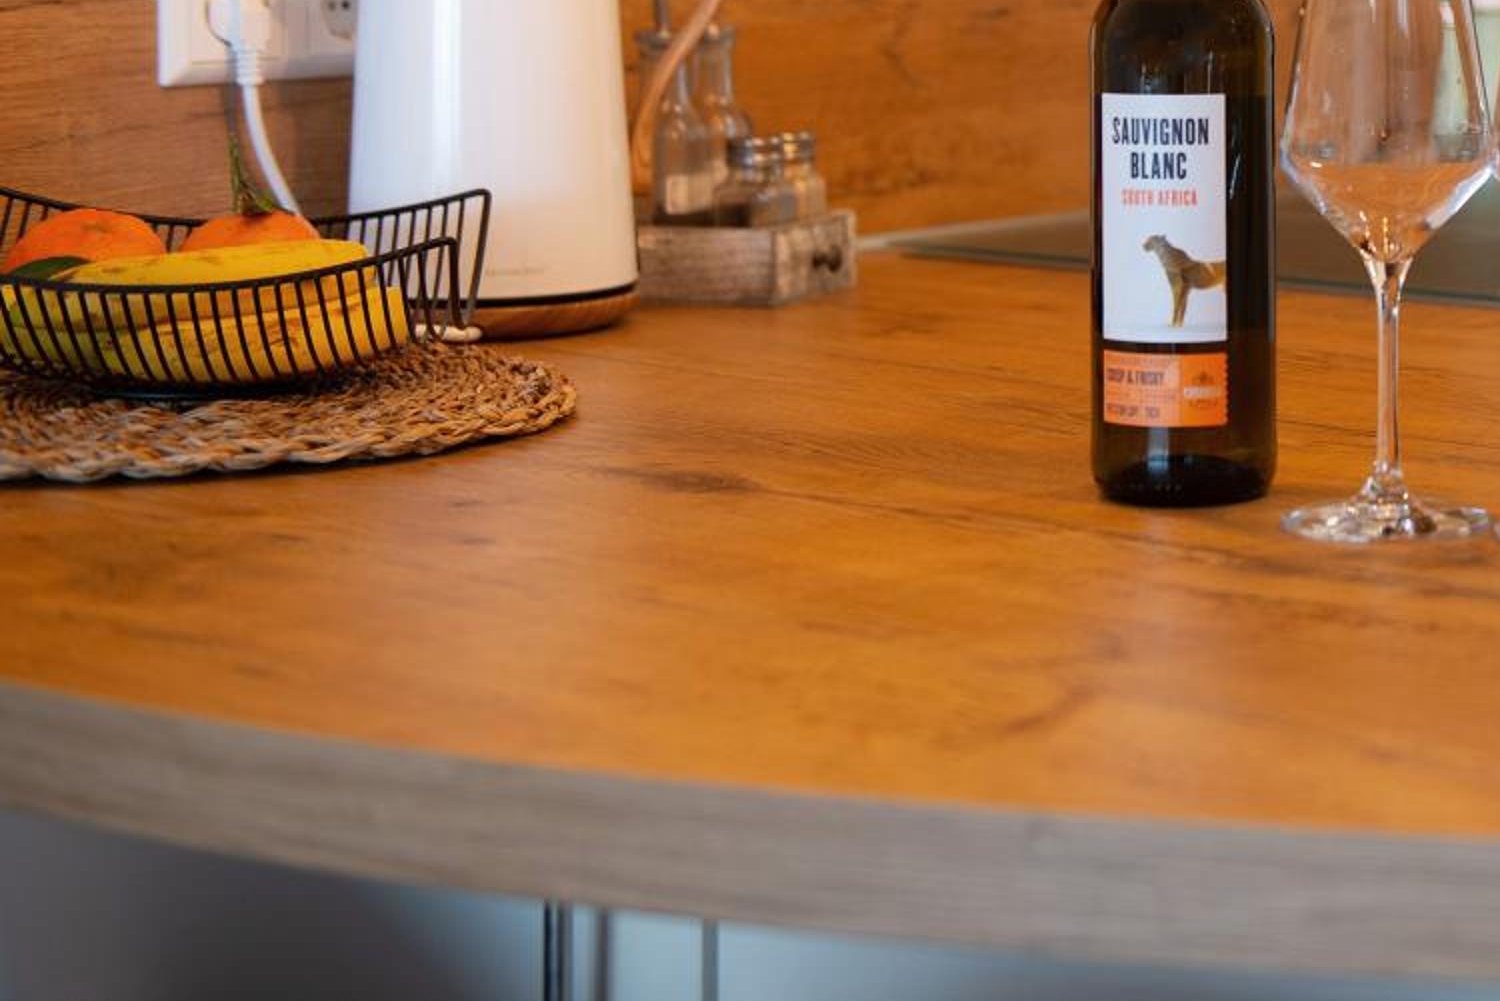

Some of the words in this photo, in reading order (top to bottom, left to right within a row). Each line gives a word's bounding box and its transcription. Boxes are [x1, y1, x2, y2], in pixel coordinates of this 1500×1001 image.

[1112, 117, 1209, 146] SAUVIGNON
[1130, 152, 1187, 180] BLANC
[1121, 189, 1153, 205] SOUTH
[1157, 189, 1198, 206] AFRICA
